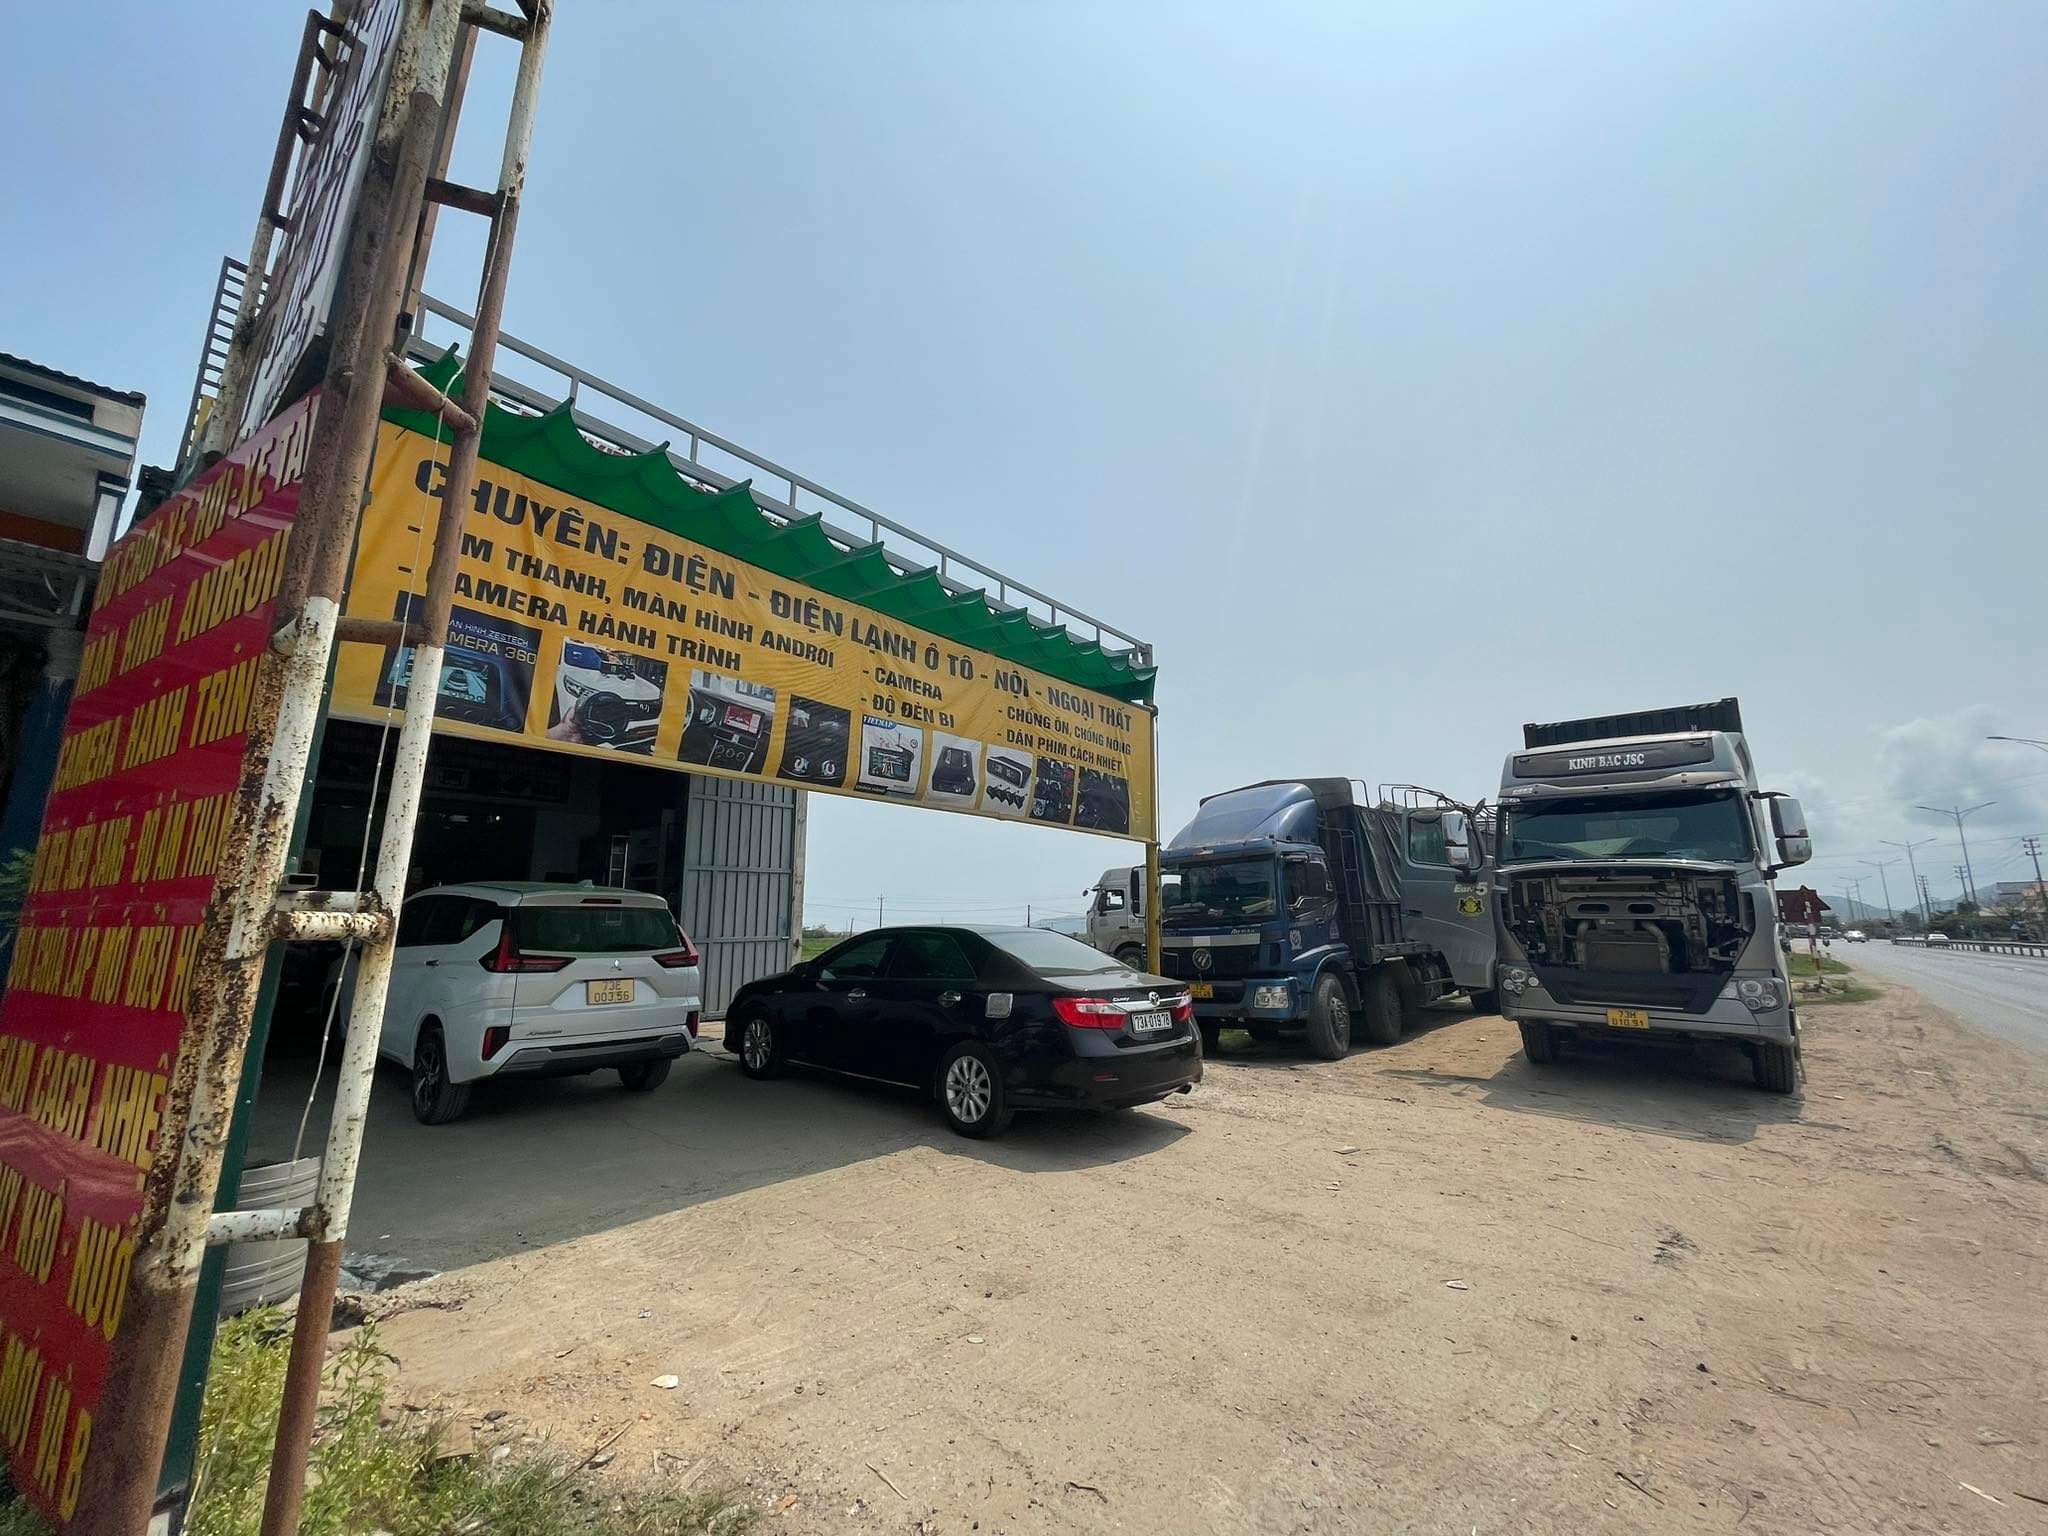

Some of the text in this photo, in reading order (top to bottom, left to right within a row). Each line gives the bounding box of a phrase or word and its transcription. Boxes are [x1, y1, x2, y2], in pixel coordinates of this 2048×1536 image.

[232, 438, 276, 519] XE
[454, 572, 567, 626] AMERA
[578, 609, 657, 650] HÀNH
[666, 634, 741, 671] TRÌNH
[505, 547, 611, 605] THANH,
[623, 587, 687, 623] MÀN
[695, 609, 753, 643] HÌNH
[760, 630, 834, 668] ANDROI
[643, 543, 735, 600] ĐIỆN
[770, 589, 844, 637] ĐIỆN
[851, 618, 917, 663] LẠNH
[925, 642, 939, 671] Ô
[947, 654, 973, 680] TÔ
[994, 670, 1029, 699] NỘI
[1048, 686, 1094, 721] NGOẠI
[1098, 706, 1132, 732] THẤT
[449, 632, 537, 665] MERA 360
[875, 667, 942, 701] CAMERA
[872, 694, 896, 717] ĐỘ
[901, 701, 934, 723] ĐÈN
[939, 711, 954, 728] BI
[1007, 728, 1033, 748] DÁN
[1037, 737, 1067, 756] PHIM
[1070, 743, 1094, 765] CÁCH
[1569, 757, 1596, 770] KINH
[1623, 753, 1645, 765] JSC
[92, 1052, 169, 1193] NHIỆ
[66, 1212, 140, 1342] NƯỚ
